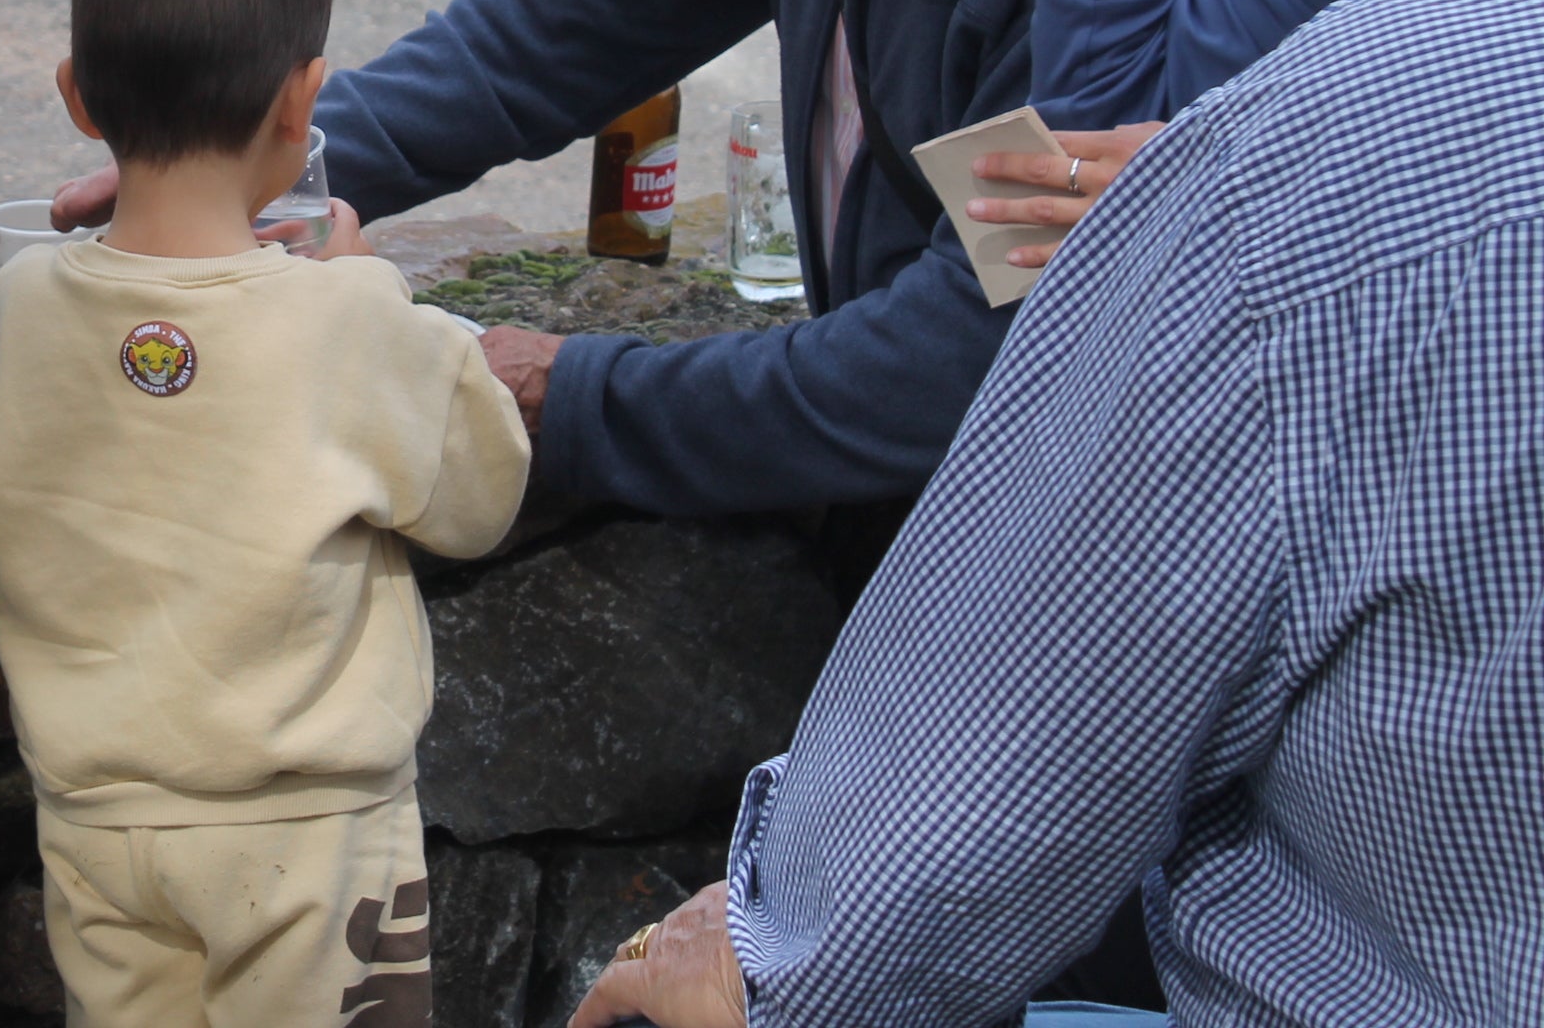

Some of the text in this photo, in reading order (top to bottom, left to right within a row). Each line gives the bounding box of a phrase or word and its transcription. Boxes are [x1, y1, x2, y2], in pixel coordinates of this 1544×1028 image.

[632, 167, 676, 192] Mah
[135, 325, 160, 338] SIMBA
[169, 330, 191, 388] THE KING
[133, 375, 167, 394] HAKUNA
